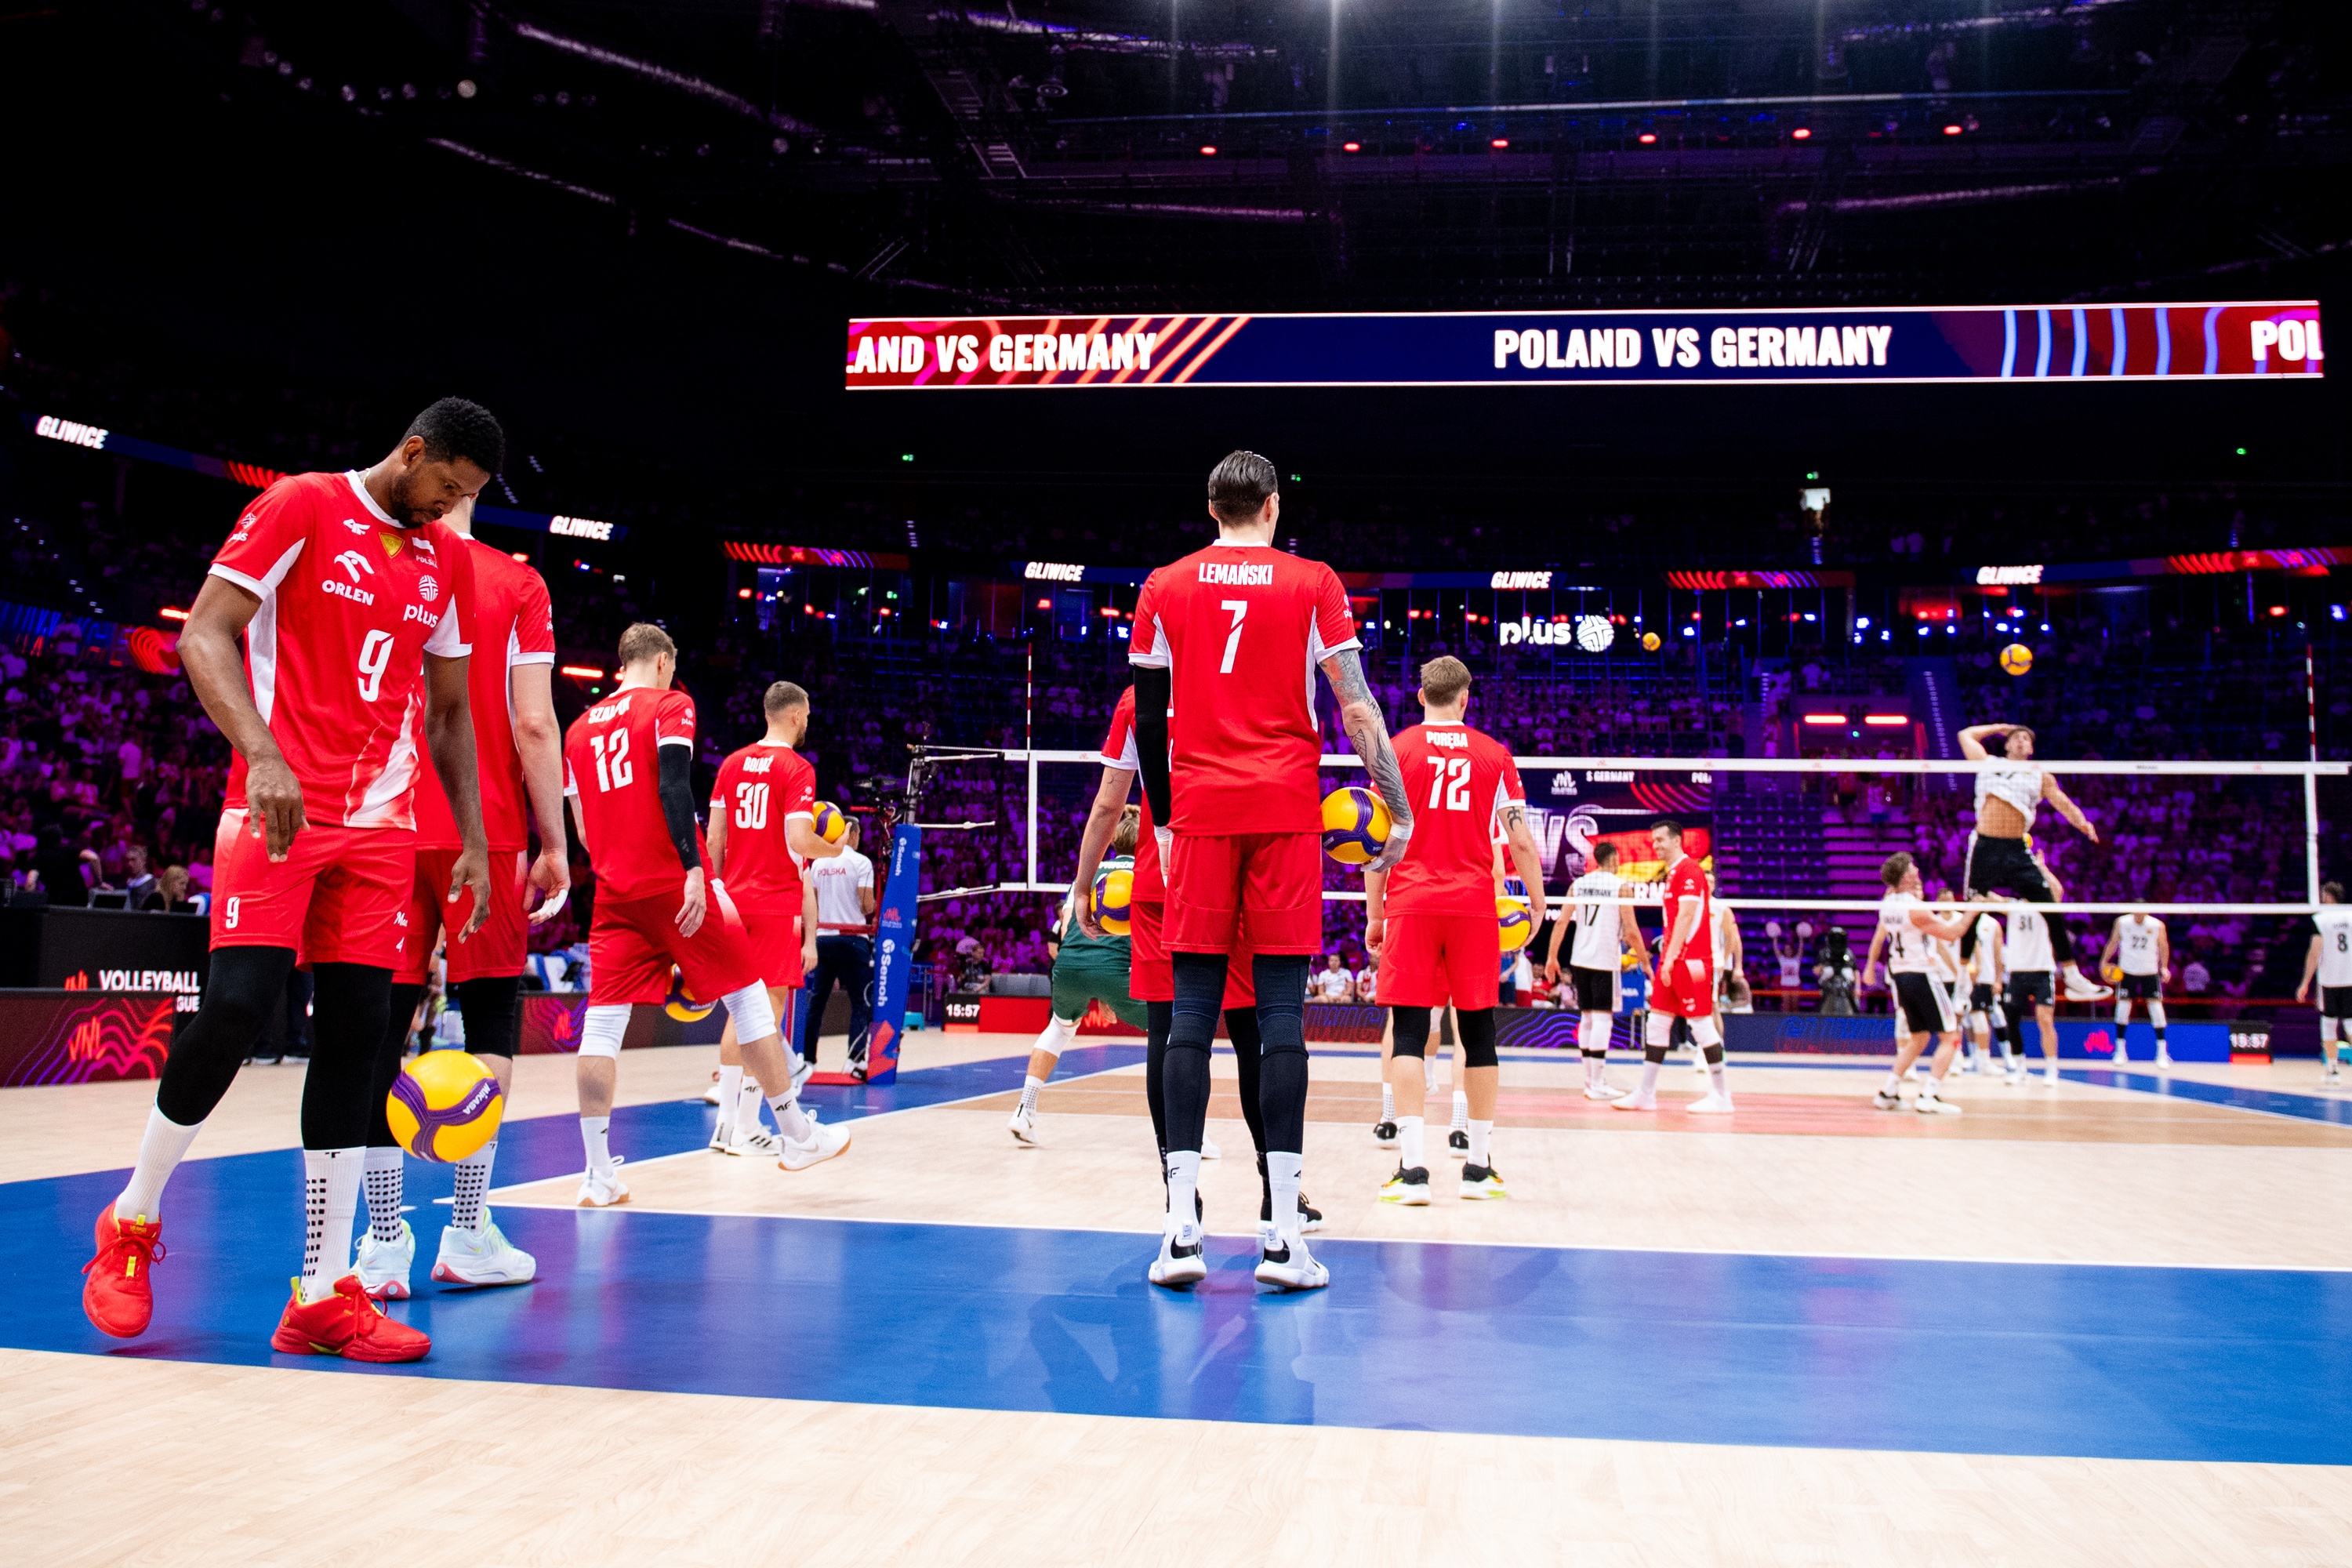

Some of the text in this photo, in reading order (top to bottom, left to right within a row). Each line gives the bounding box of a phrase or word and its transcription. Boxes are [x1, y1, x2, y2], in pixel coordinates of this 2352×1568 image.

[846, 332, 1157, 373] AND VS GERMANY
[1494, 326, 1892, 368] POLAND VS GERMANY
[35, 416, 109, 449] GLIWICE
[550, 515, 614, 541] GLIWICE
[1024, 561, 1085, 582] GLIWICE
[1198, 561, 1274, 586] LEMAŃSKI
[1490, 571, 1553, 589] GLIWICE
[1976, 564, 2044, 585] GLIWICE
[321, 579, 375, 606] ORLEN
[402, 603, 439, 628] plus
[1219, 600, 1248, 674] 7
[1499, 615, 1572, 647] plus
[358, 629, 395, 702] 9
[1425, 731, 1468, 750] PORĘBA
[590, 727, 633, 793] 12
[1427, 756, 1471, 811] 72
[735, 782, 770, 829] 30
[818, 866, 847, 877] POLSKA
[225, 896, 239, 929] 9
[1584, 904, 1600, 927] 17
[2019, 914, 2033, 931] 31
[2337, 931, 2349, 952] 8
[100, 969, 201, 993] VOLLEYBALL
[877, 953, 891, 1007] Senoh
[946, 1004, 981, 1018] 15:57
[2230, 1033, 2269, 1048] 15:57
[463, 1083, 491, 1115] MIKASA
